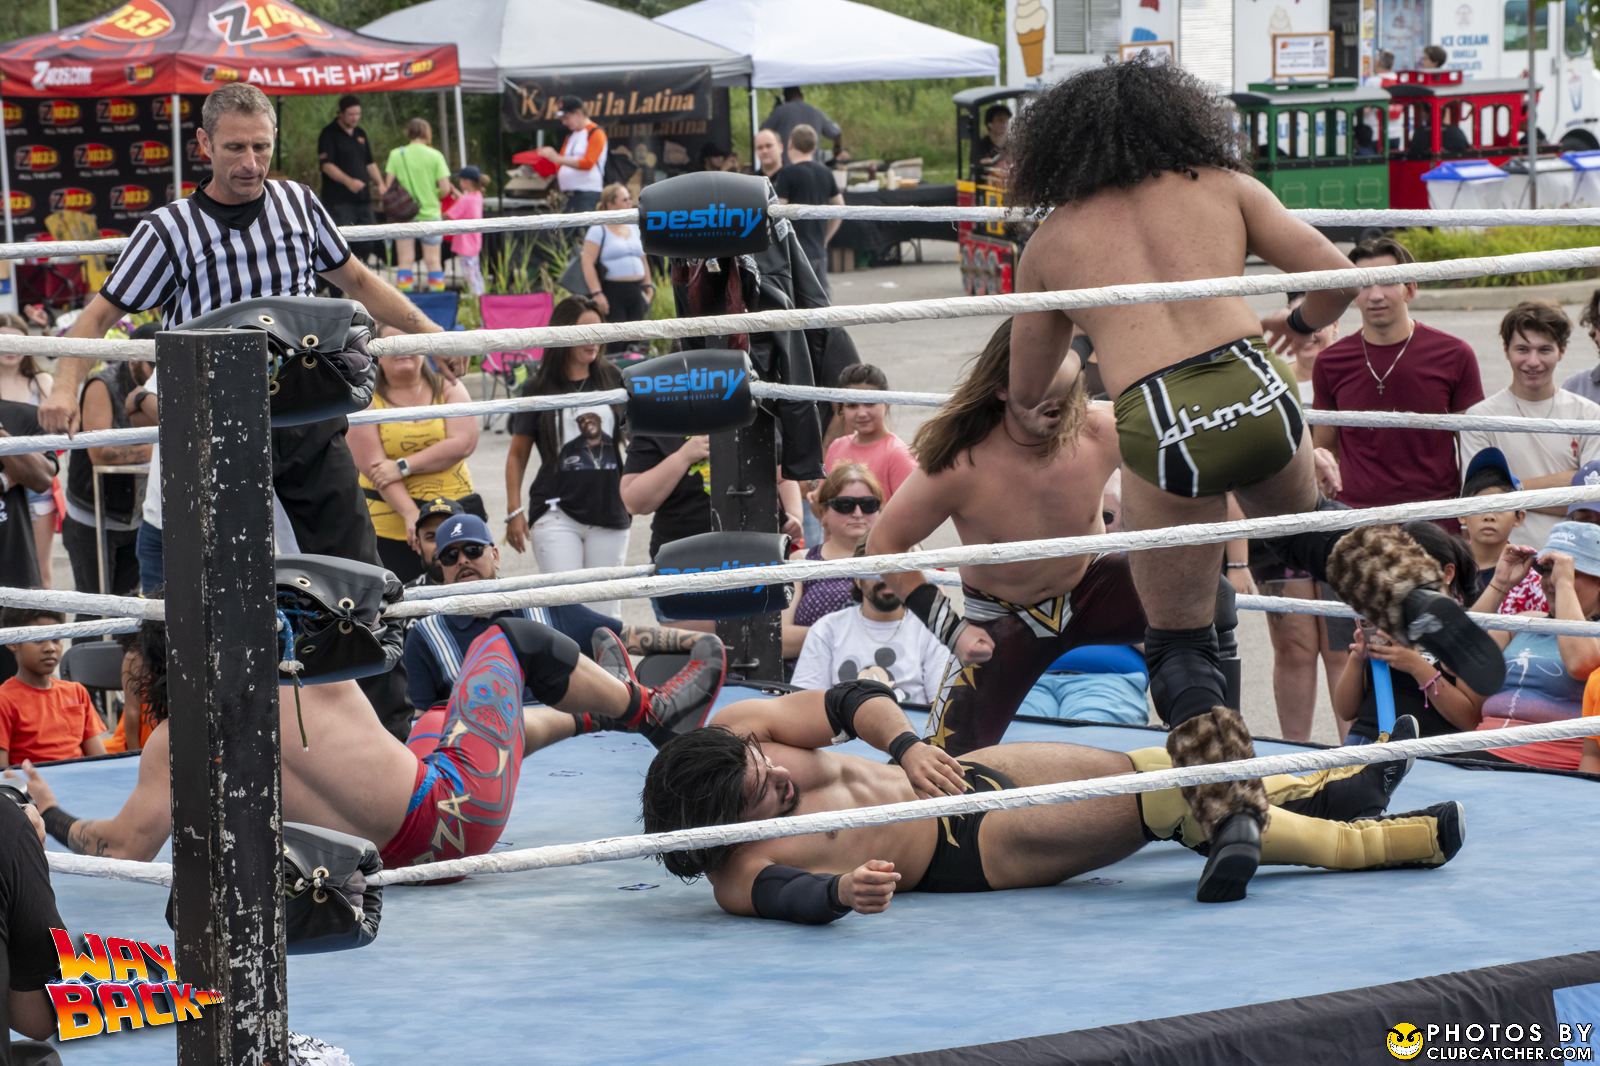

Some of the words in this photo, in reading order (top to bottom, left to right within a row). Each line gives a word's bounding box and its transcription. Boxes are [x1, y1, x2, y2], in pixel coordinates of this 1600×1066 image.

[1441, 36, 1454, 47] ICE
[1456, 35, 1489, 47] CREAM
[247, 68, 295, 87] ALL
[297, 65, 346, 86] THE
[349, 62, 401, 82] HITS
[521, 88, 539, 116] K
[604, 91, 626, 116] la
[628, 88, 695, 115] Latina
[646, 203, 763, 238] Destiny
[630, 367, 746, 401] Destiny
